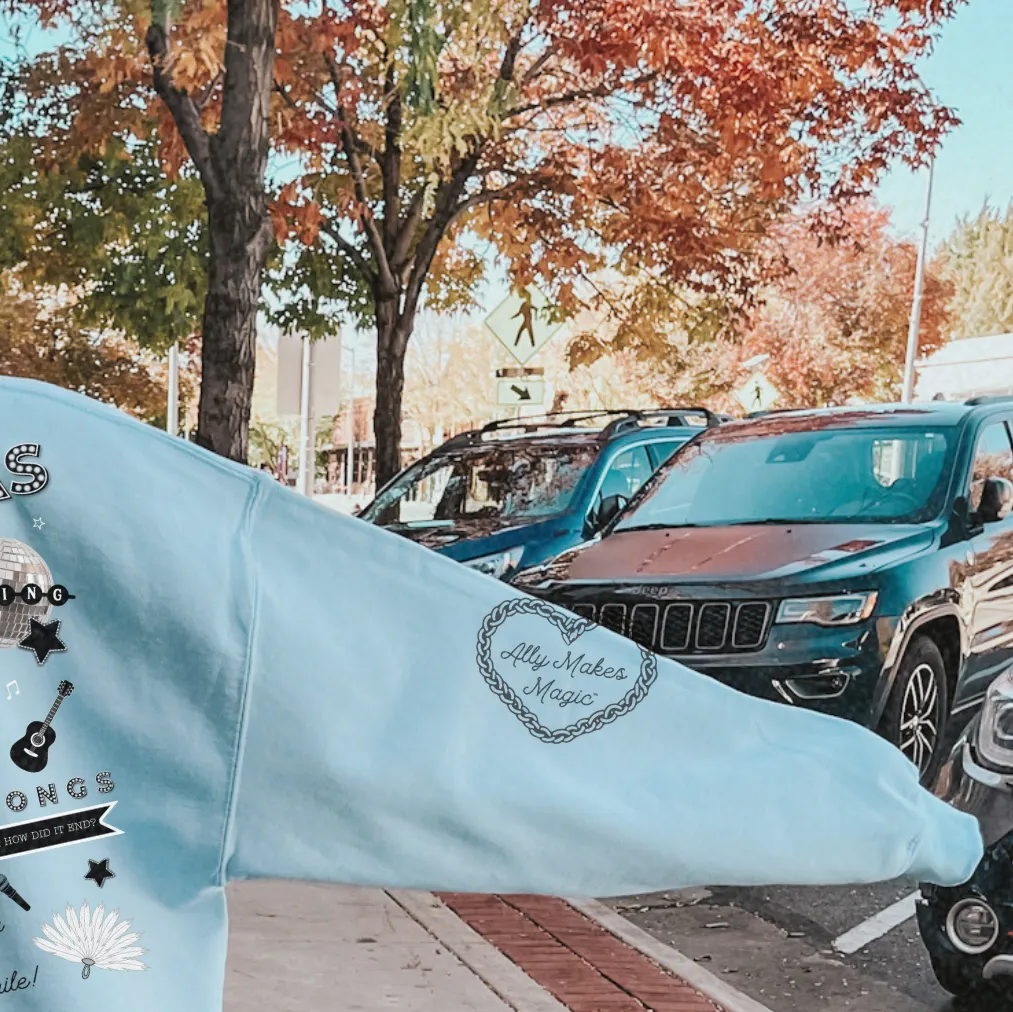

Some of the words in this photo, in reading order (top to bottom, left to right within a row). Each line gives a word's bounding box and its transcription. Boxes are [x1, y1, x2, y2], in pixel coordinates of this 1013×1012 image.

[632, 585, 668, 598] Jeep
[500, 642, 550, 671] Ally
[552, 651, 628, 681] Makes
[4, 832, 29, 846] HOW
[31, 827, 51, 840] DID
[54, 824, 65, 836] IT
[68, 818, 97, 833] END?
